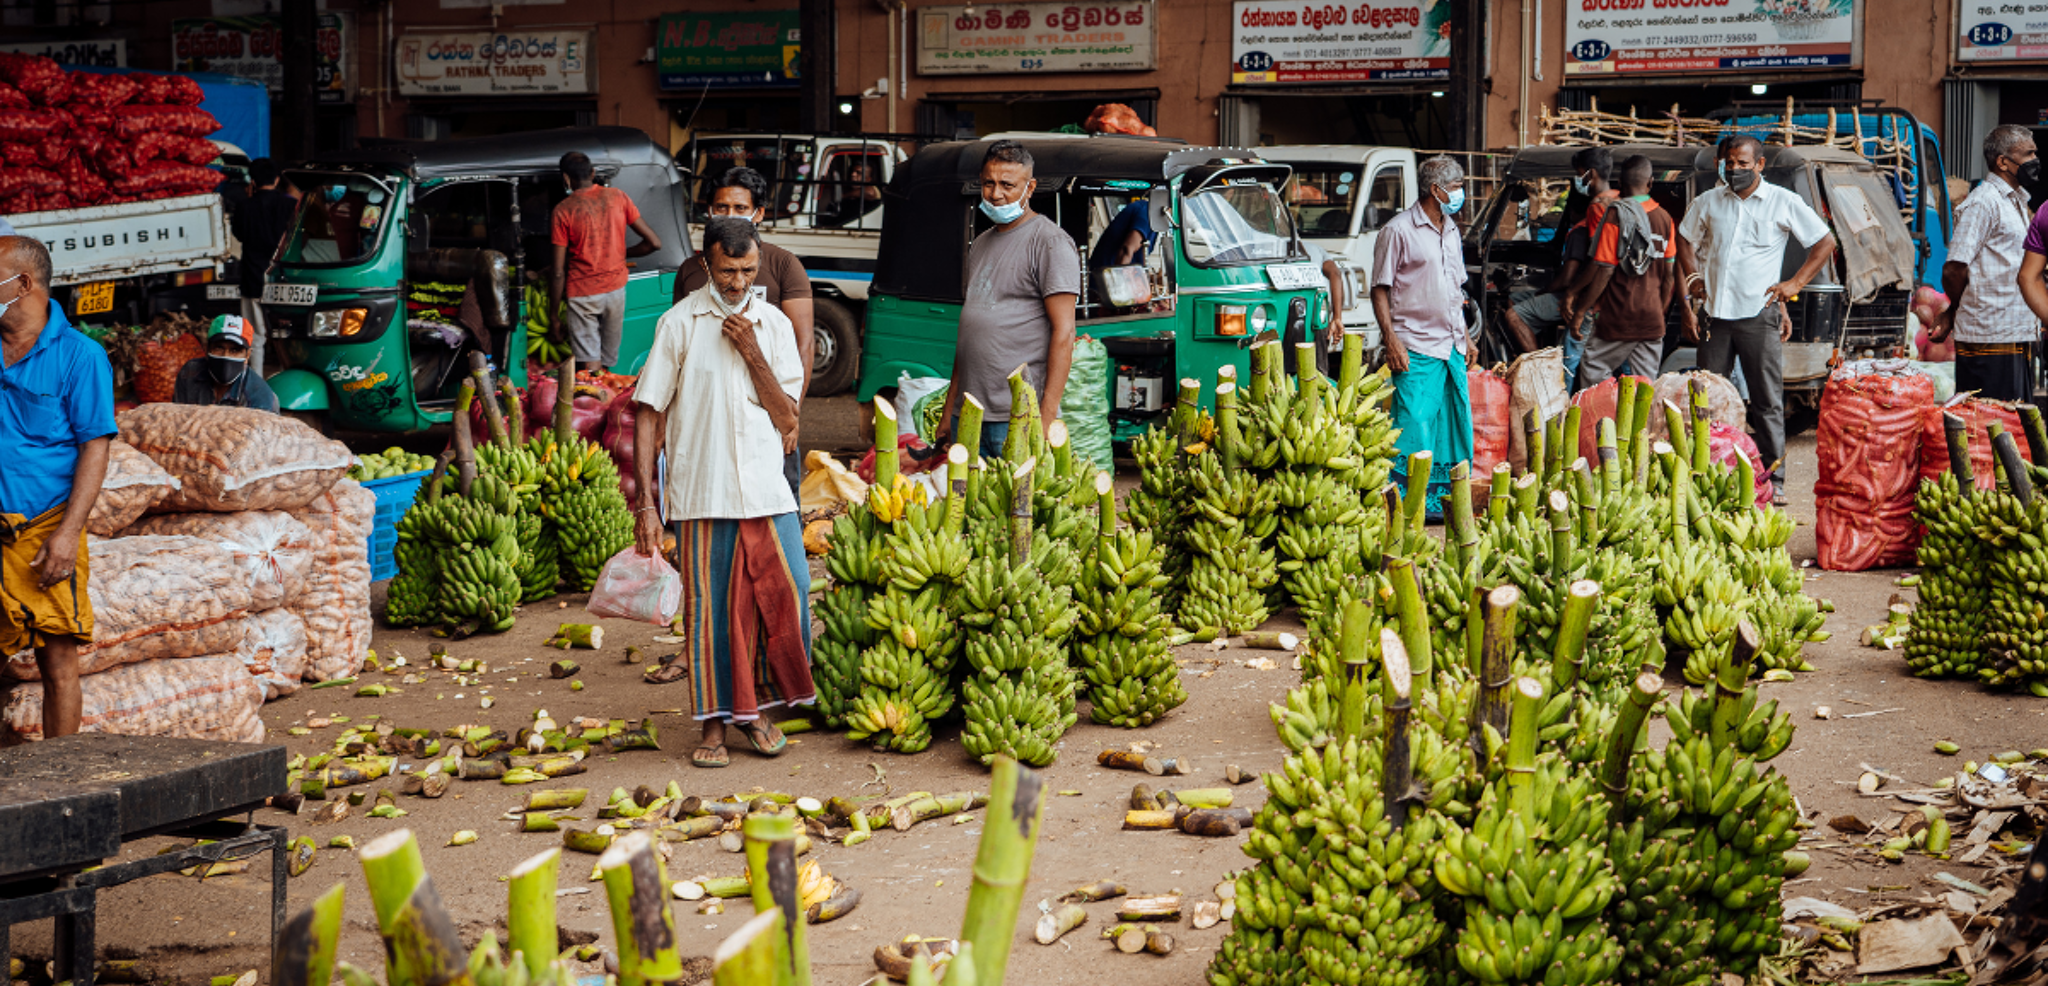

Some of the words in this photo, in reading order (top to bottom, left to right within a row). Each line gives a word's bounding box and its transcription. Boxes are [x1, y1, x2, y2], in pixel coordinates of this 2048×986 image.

[960, 35, 1025, 47] GAMINI
[1035, 32, 1125, 44] TRADERS
[446, 65, 491, 78] RATHNA
[494, 64, 547, 77] TRADERS
[45, 226, 185, 252] TSUBISHI
